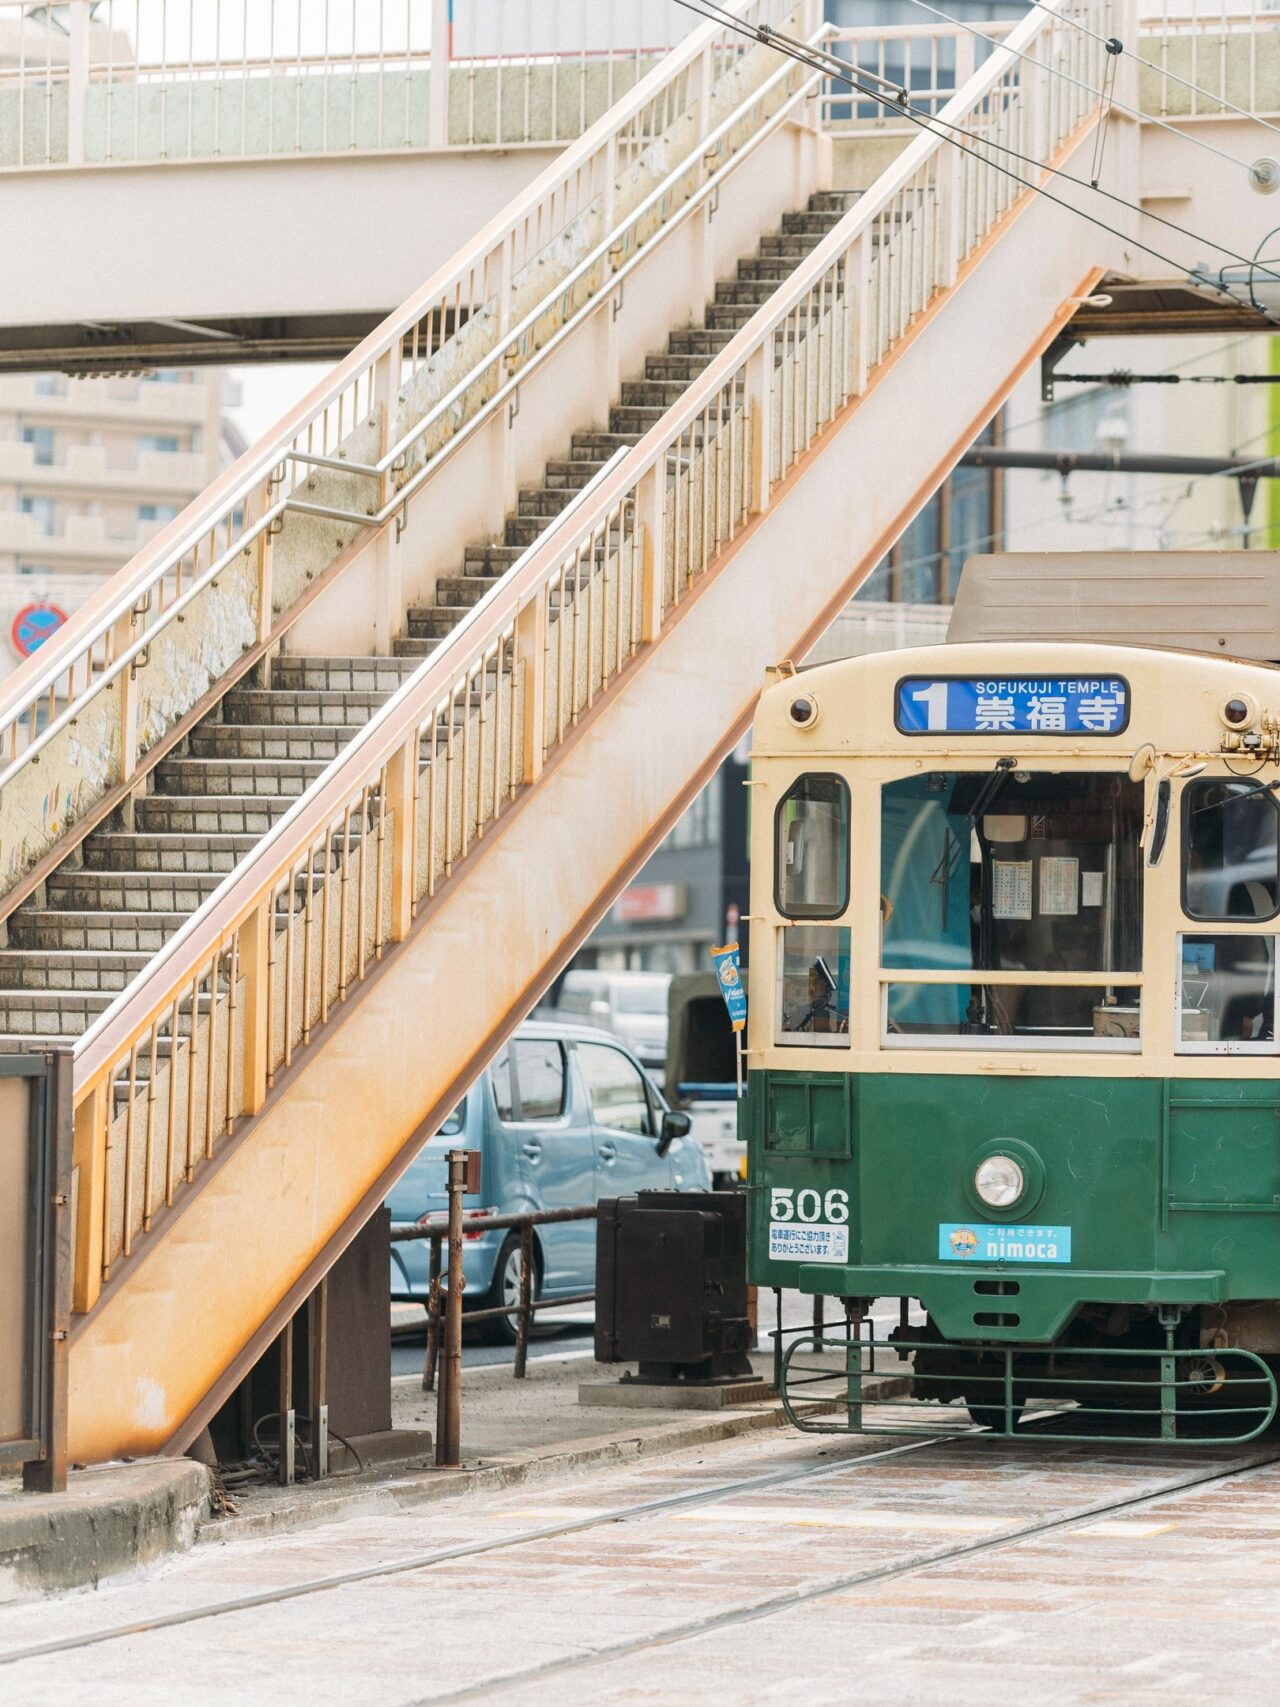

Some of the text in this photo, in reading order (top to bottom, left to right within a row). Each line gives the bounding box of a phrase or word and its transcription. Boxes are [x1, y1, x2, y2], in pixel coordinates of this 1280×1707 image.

[975, 681, 1119, 695] SOFUKUJI TEMPLE
[912, 682, 948, 731] 1
[975, 695, 1119, 731] 崇福寺
[770, 1187, 850, 1224] 506
[986, 1238, 1058, 1259] nimoca
